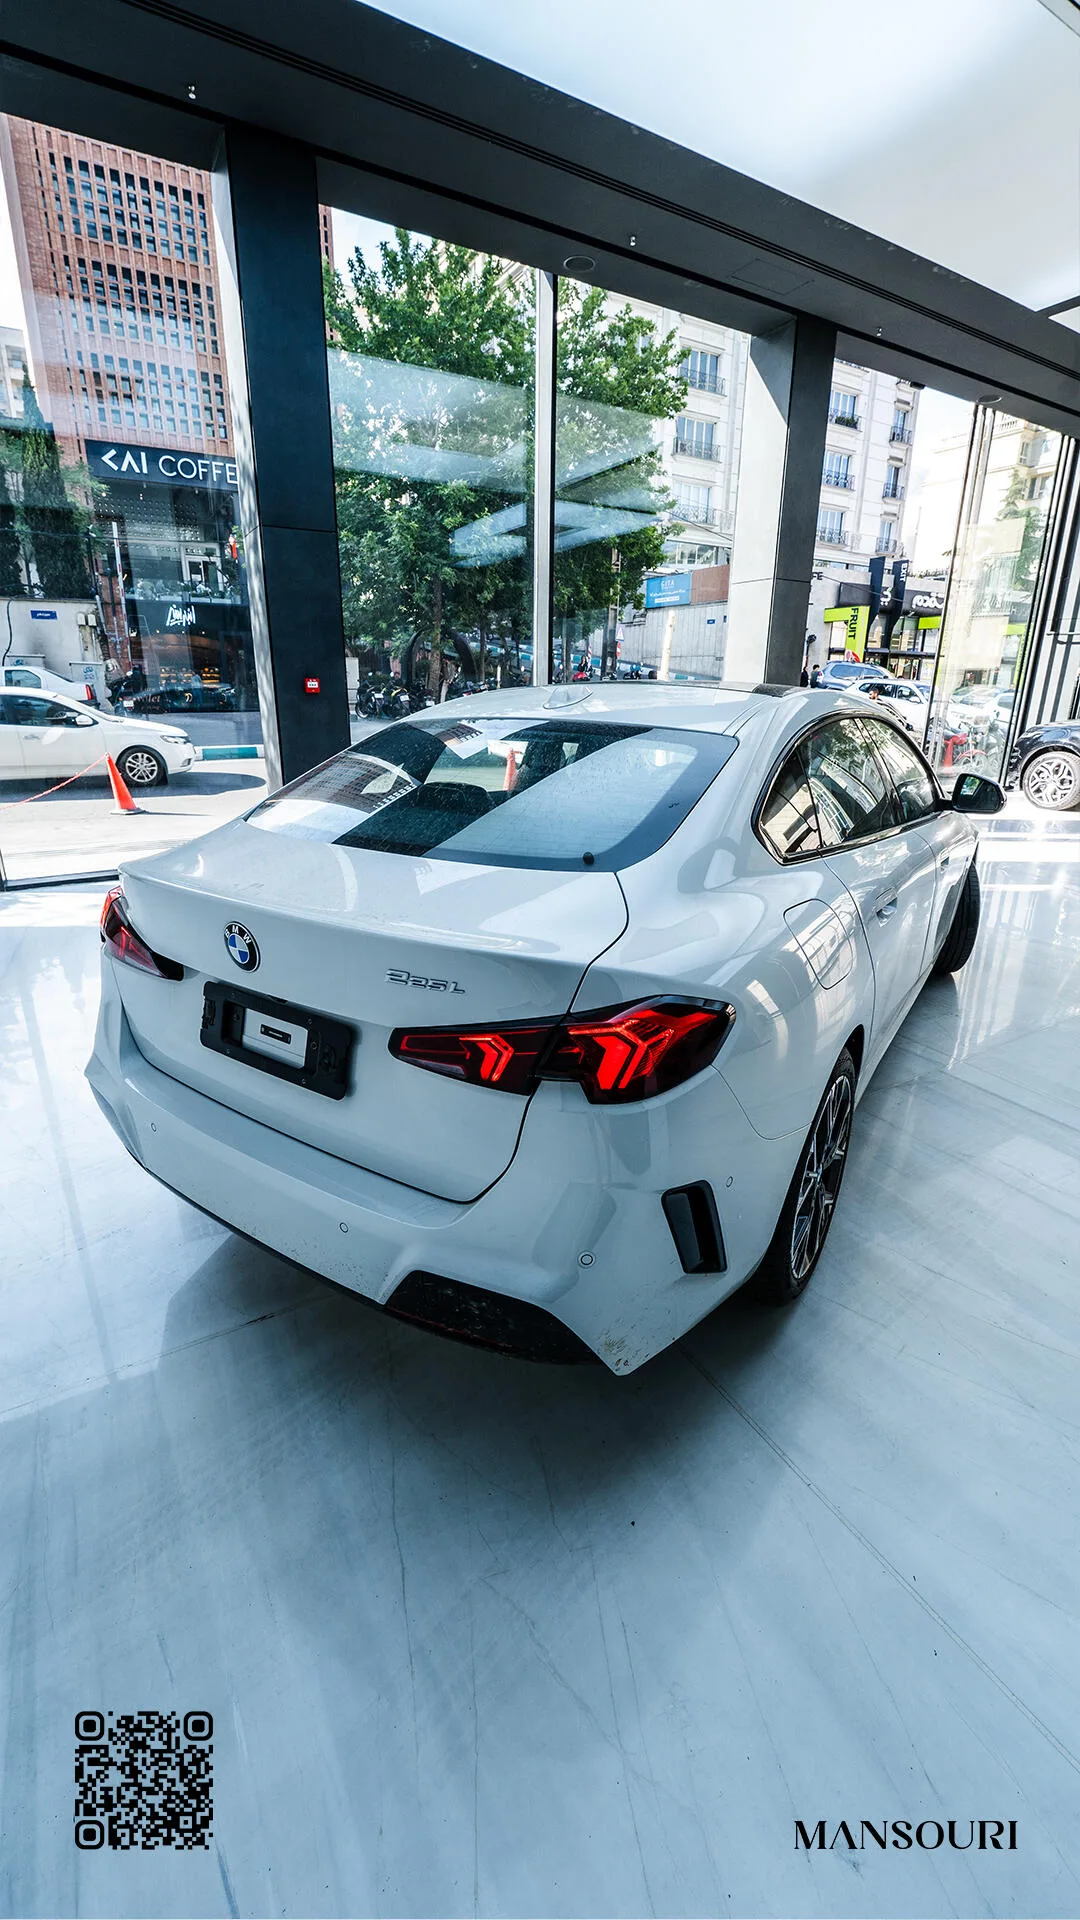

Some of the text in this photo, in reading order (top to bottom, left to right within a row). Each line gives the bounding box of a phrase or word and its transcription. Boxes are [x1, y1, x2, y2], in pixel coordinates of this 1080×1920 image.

[899, 562, 908, 583] EXIT
[847, 607, 860, 640] FRUIT
[224, 924, 252, 944] BMW
[385, 968, 466, 995] 225L
